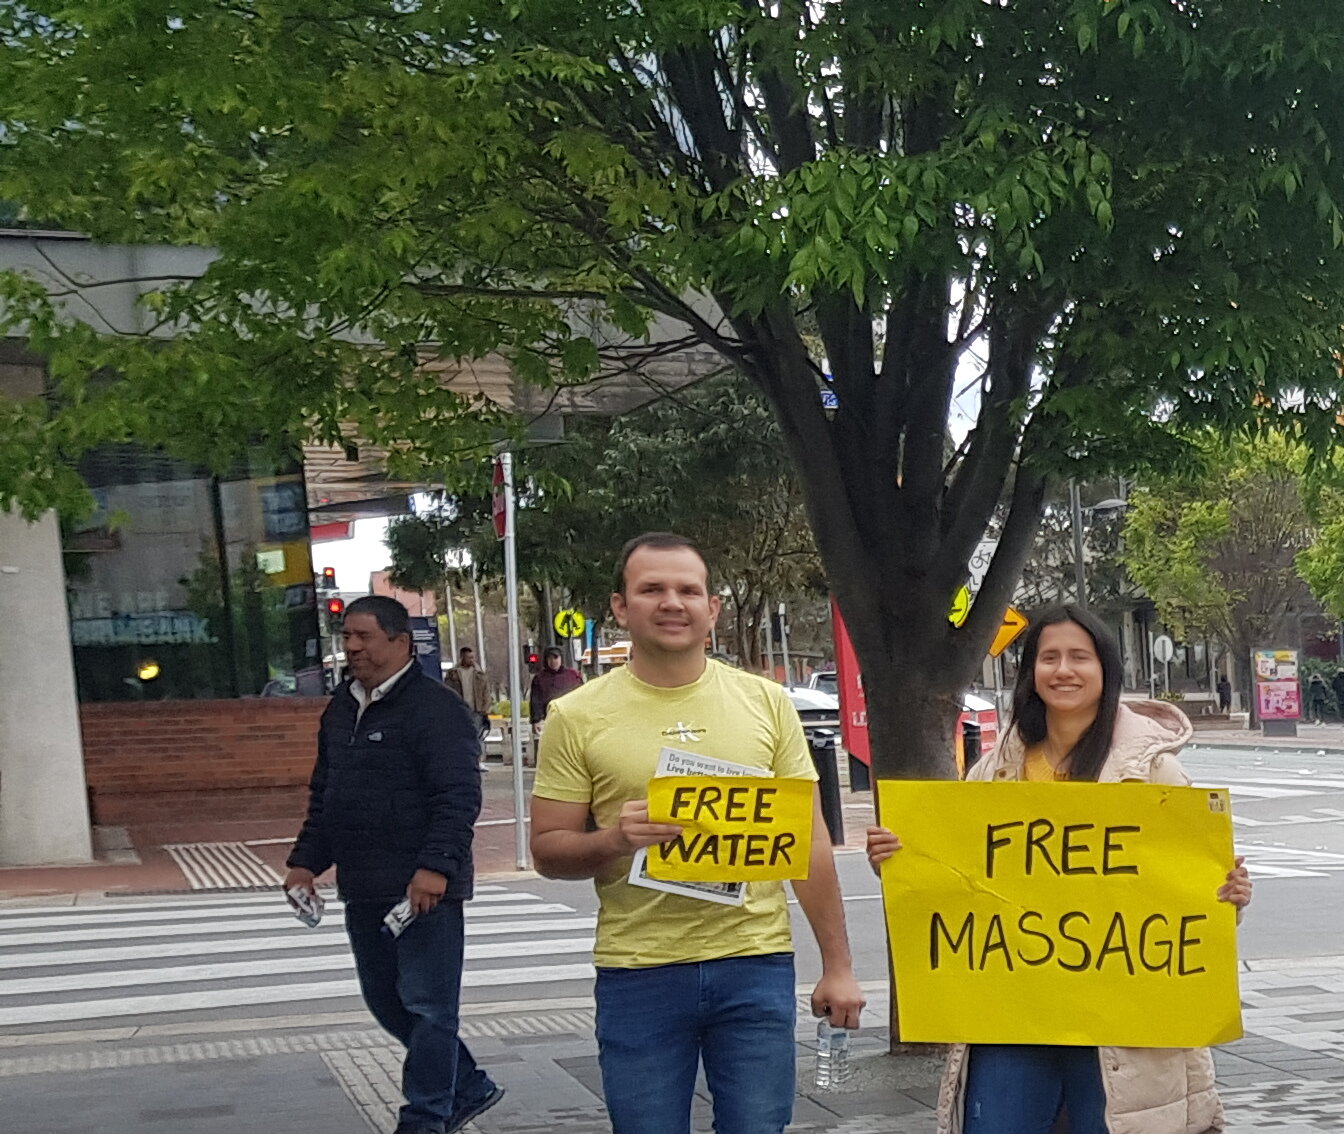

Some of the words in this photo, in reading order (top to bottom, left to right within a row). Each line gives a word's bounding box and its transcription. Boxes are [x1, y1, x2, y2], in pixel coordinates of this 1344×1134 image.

[666, 763, 685, 775] Live
[668, 753, 680, 763] Do
[681, 758, 695, 767] you
[669, 786, 778, 824] FREE
[658, 832, 796, 867] WATER
[985, 818, 1141, 879] FREE
[929, 910, 1208, 977] MASSAGE
